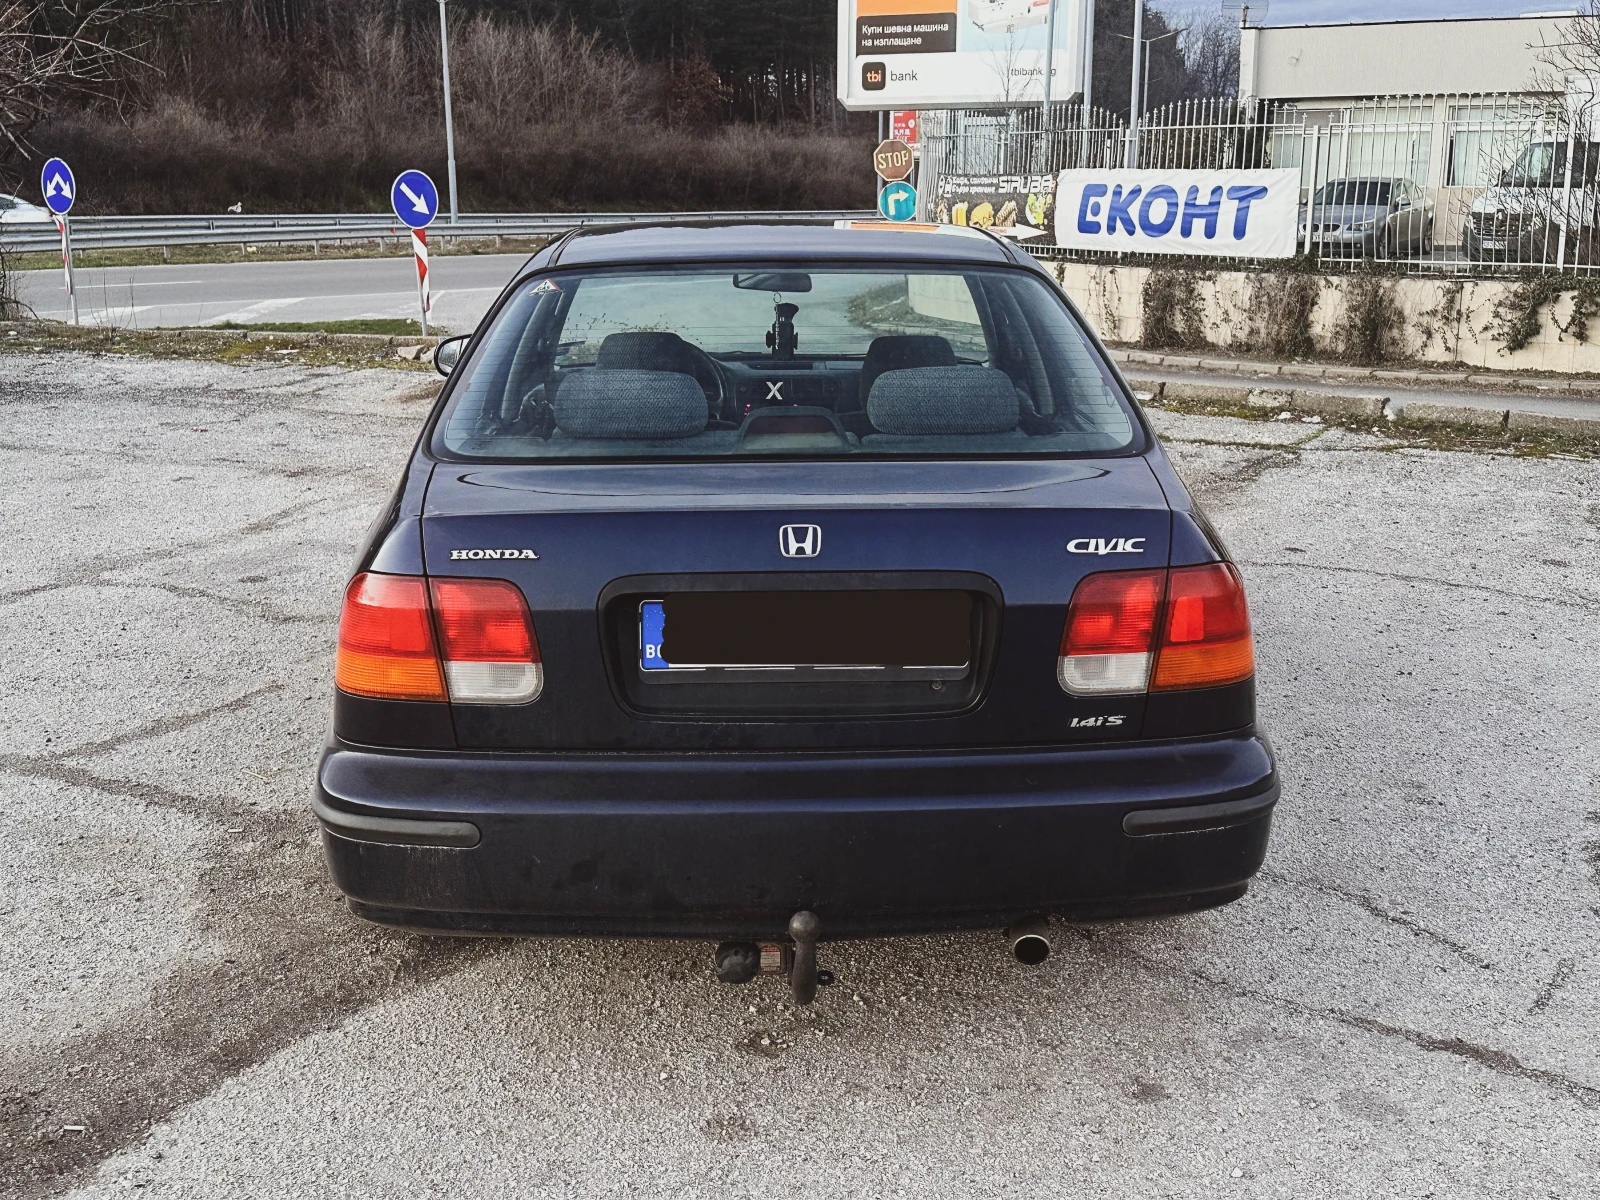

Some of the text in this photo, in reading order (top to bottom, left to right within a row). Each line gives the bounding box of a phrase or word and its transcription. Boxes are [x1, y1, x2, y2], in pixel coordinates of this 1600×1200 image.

[862, 23, 949, 35] Купи шевна машина
[861, 37, 922, 46] на изплащане
[866, 70, 918, 82] tbi bank
[1010, 67, 1057, 77] tbibank.g
[878, 151, 908, 169] STOP
[1077, 183, 1268, 240] ЕКОНТ
[1066, 537, 1146, 555] CIVIC
[450, 549, 537, 560] HONDA
